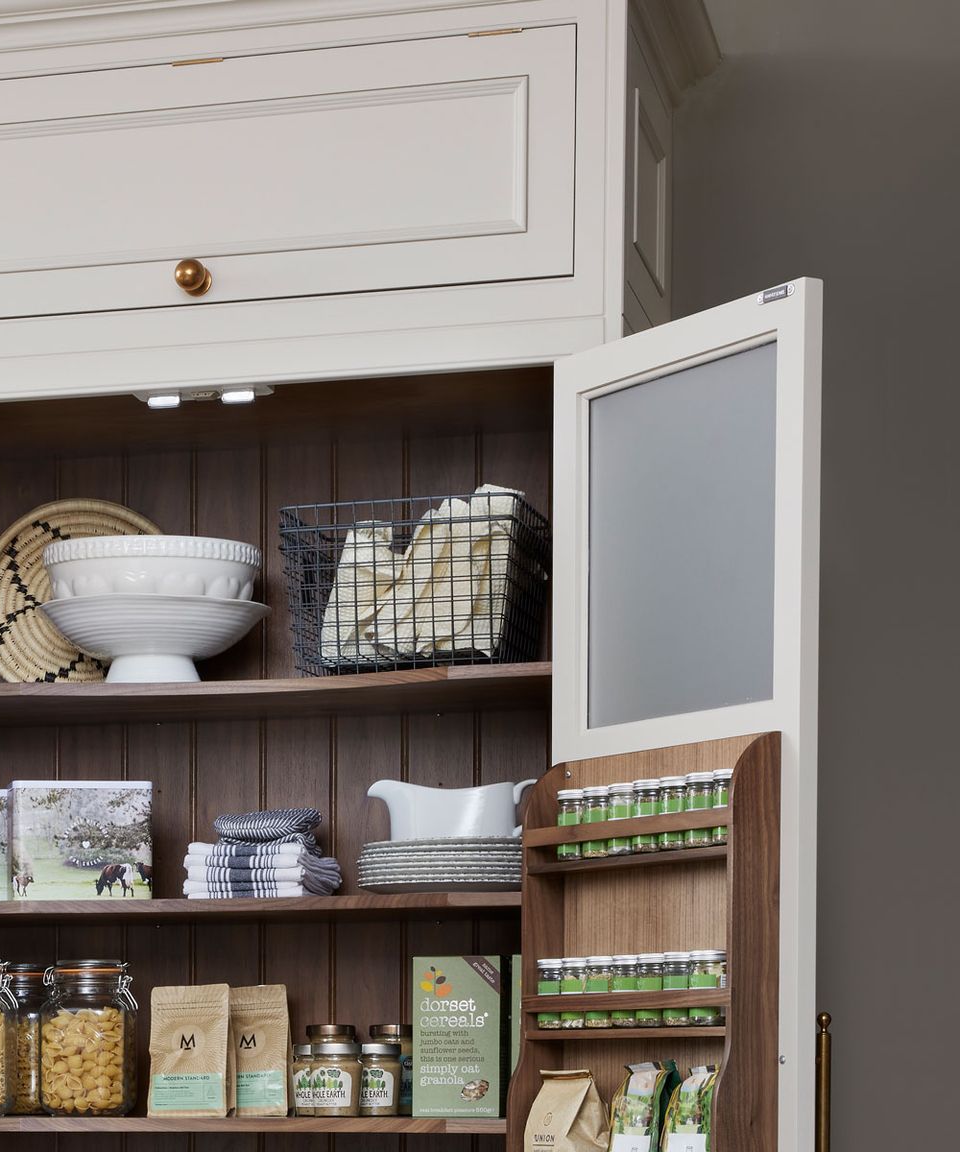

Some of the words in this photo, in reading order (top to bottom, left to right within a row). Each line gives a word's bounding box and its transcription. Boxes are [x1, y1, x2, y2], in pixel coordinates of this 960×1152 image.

[420, 997, 477, 1012] dorset
[420, 1012, 486, 1028] cereals
[420, 1030, 452, 1039] bursting
[419, 1038, 443, 1047] jumbo
[460, 1038, 476, 1046] and
[420, 1055, 435, 1063] this
[435, 1055, 442, 1063] is
[457, 1055, 486, 1063] serious
[420, 1063, 459, 1076] simply
[461, 1064, 481, 1074] oat
[420, 1075, 465, 1087] granola
[326, 1090, 346, 1098] EARTH
[369, 1090, 388, 1098] EARTH
[533, 1134, 555, 1142] UNION
